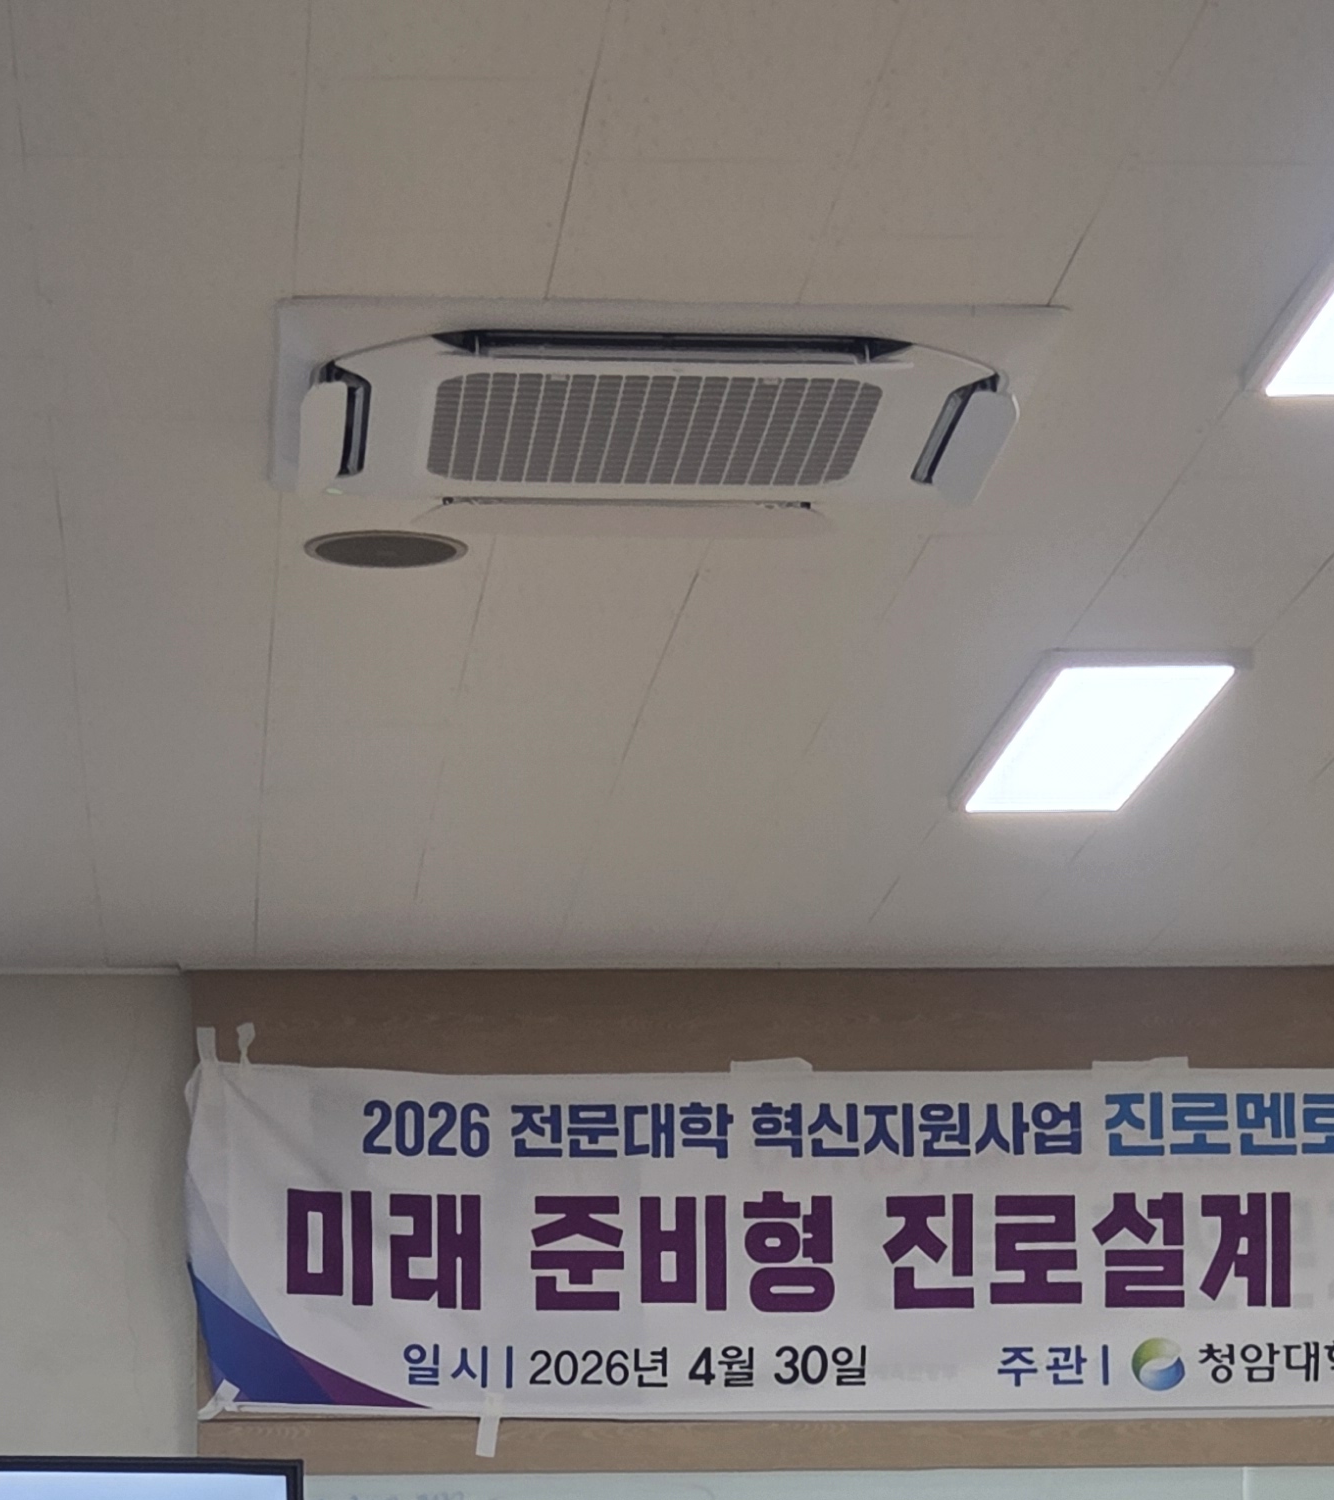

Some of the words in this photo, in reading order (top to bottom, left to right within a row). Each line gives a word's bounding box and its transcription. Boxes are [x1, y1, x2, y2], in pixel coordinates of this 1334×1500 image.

[362, 1099, 490, 1158] 2026
[510, 1101, 734, 1160] 전문대학
[751, 1101, 1082, 1159] 혁신지원사업
[286, 1187, 482, 1311] 미래
[530, 1190, 836, 1313] 준비형
[882, 1191, 1292, 1310] 진로설계
[529, 1345, 669, 1388] 2026년
[688, 1345, 754, 1388] 4월
[773, 1344, 867, 1387] 30일
[997, 1344, 1088, 1387] 주관
